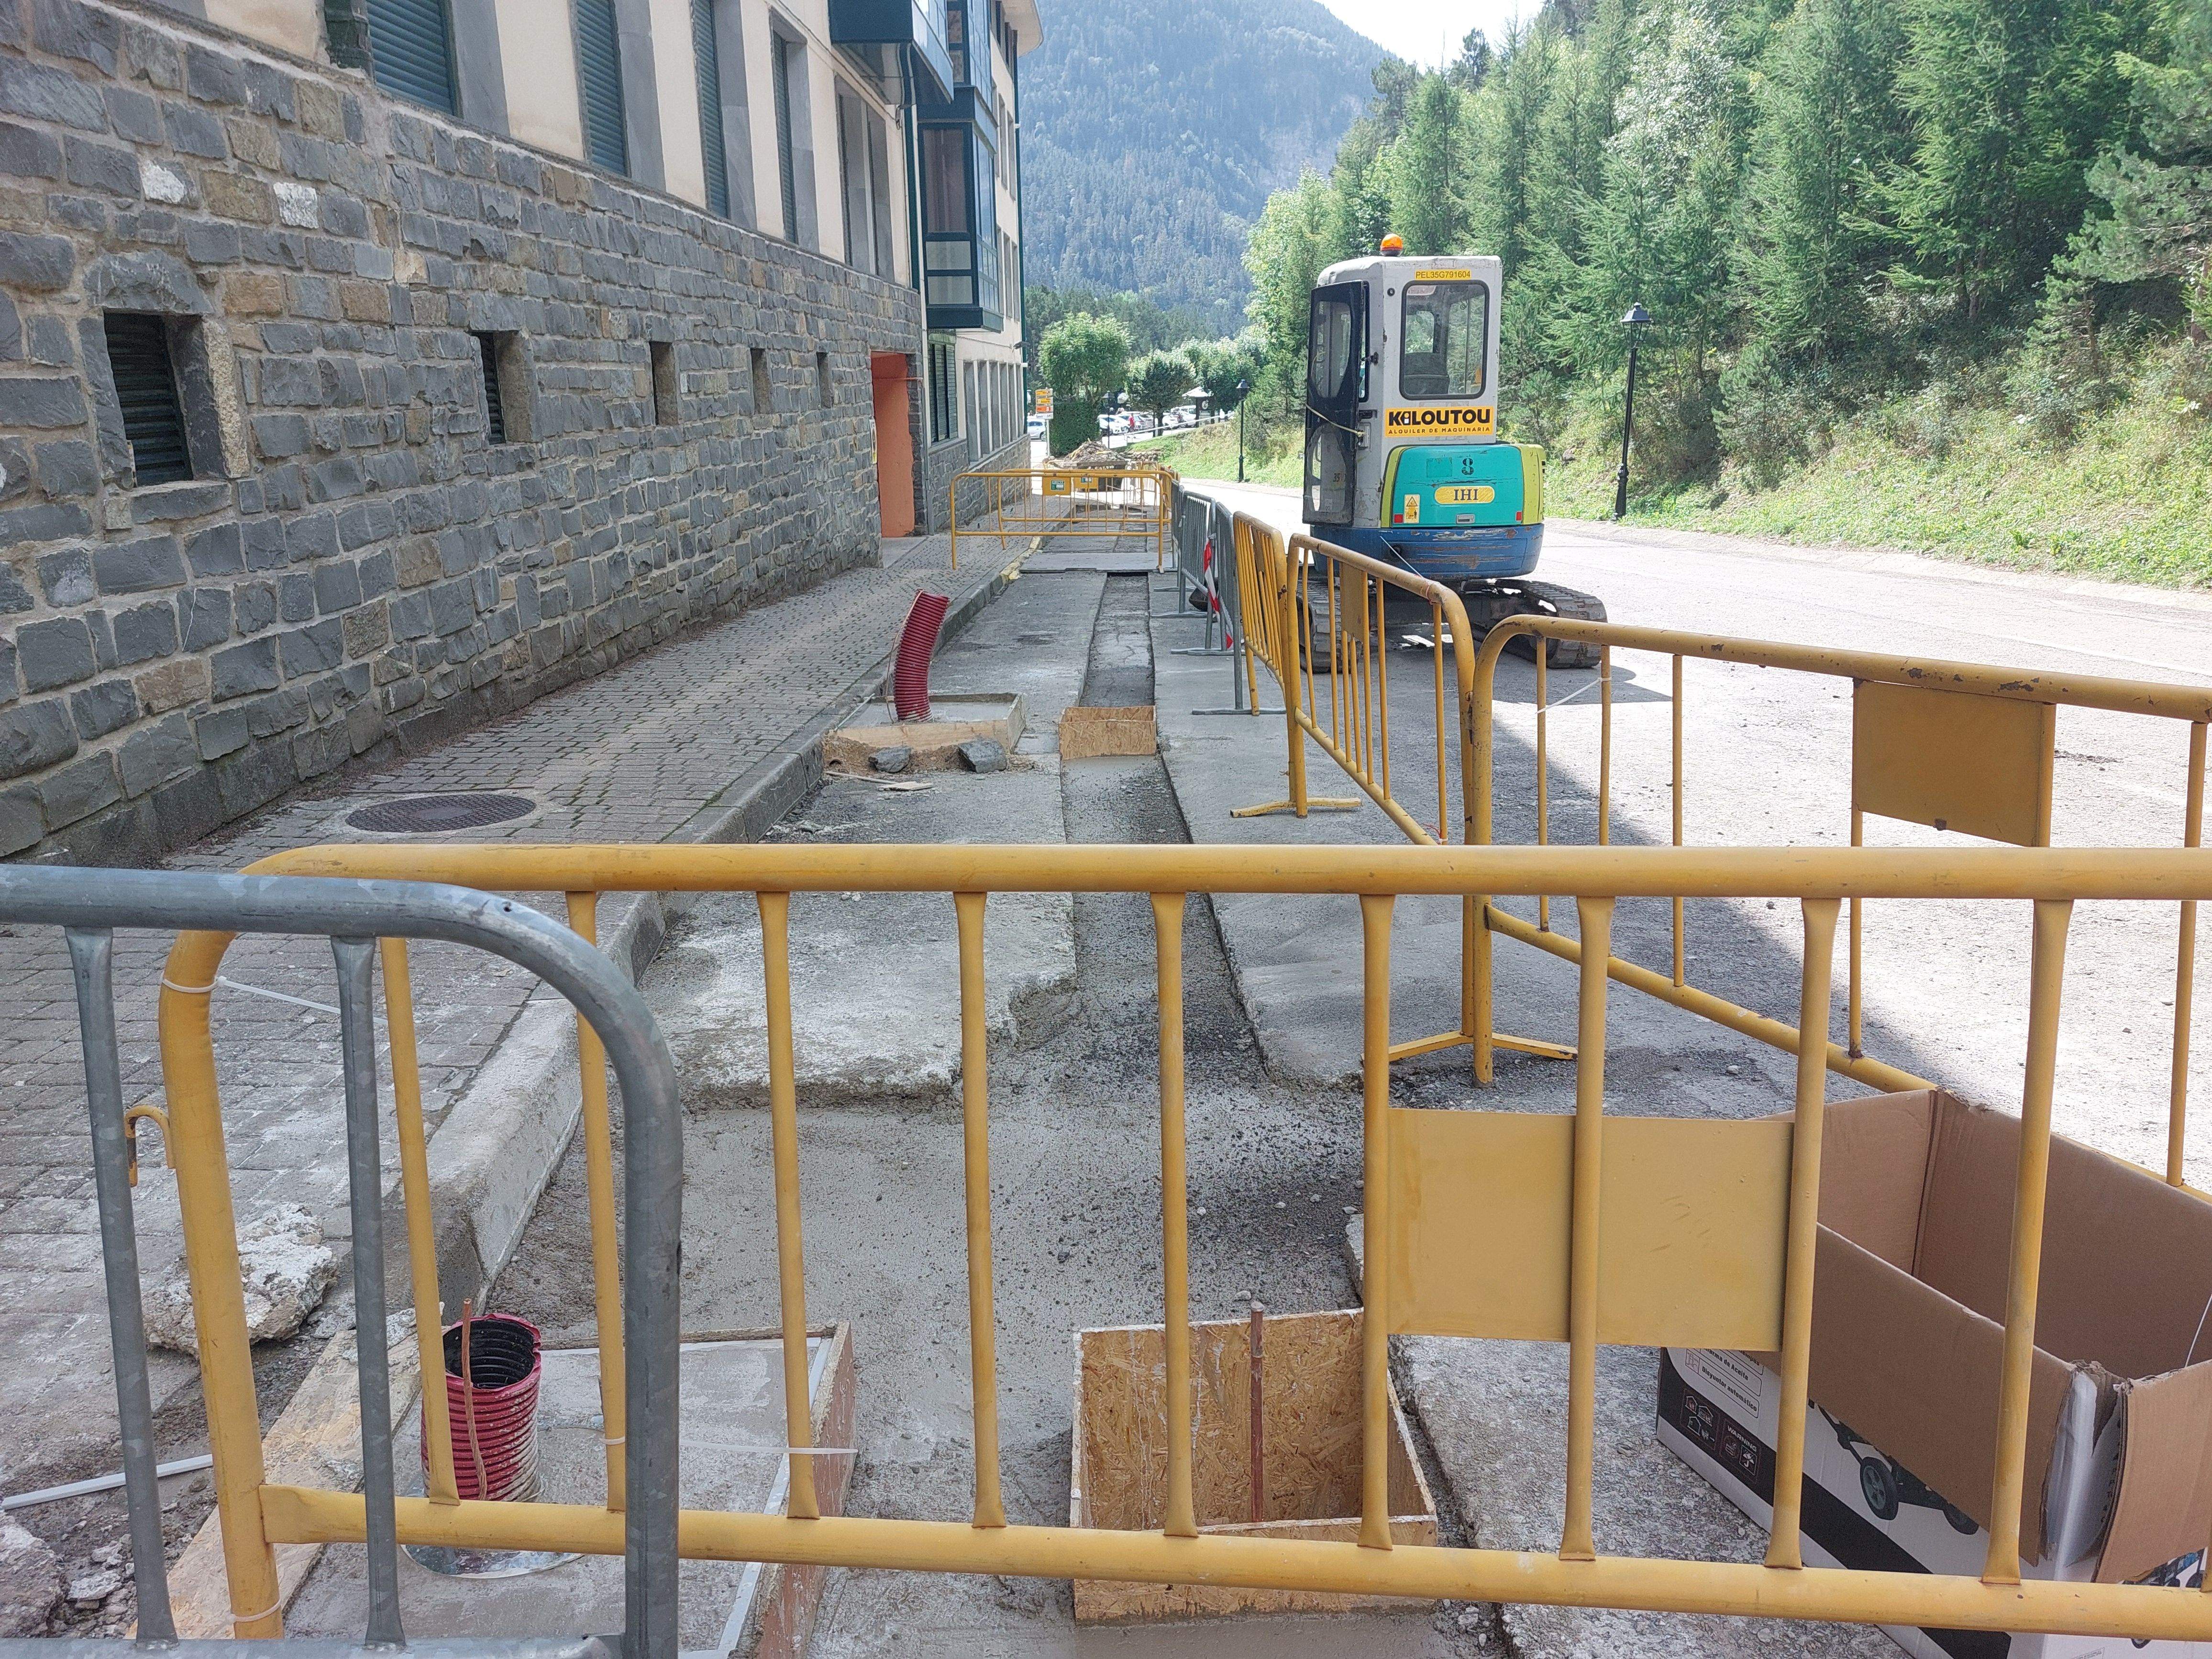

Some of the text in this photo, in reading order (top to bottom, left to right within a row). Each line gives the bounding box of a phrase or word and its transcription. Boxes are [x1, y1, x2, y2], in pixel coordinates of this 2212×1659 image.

[1453, 489, 1479, 501] IHI
[1724, 1358, 1730, 1367] de
[1731, 1364, 1748, 1381] Aceite
[1702, 1366, 1757, 1412] Disyuntor automático
[1727, 1425, 1757, 1452] WARNING
